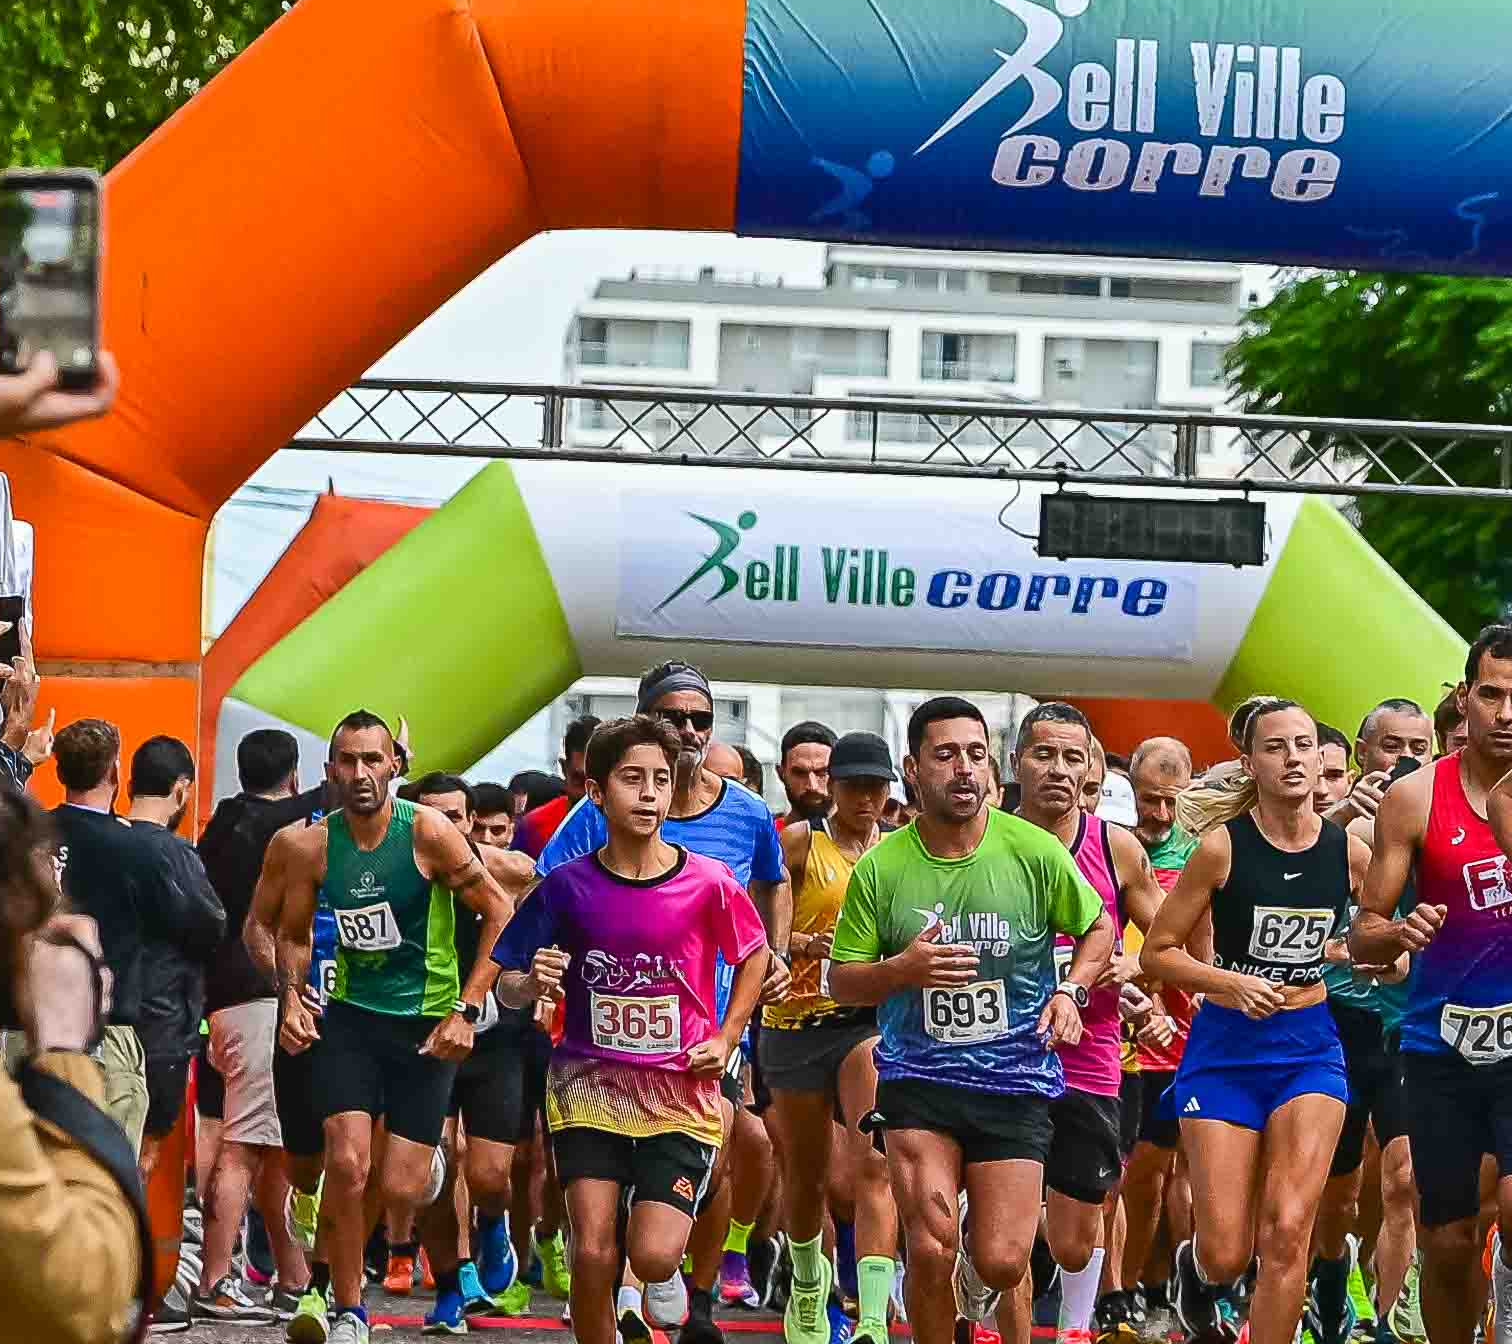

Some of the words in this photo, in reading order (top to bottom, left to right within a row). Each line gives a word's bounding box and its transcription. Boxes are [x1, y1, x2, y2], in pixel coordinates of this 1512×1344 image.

[1191, 41, 1345, 143] Ville
[992, 135, 1341, 201] corre
[822, 545, 915, 607] Ville
[926, 567, 1168, 618] corre
[340, 909, 387, 943] 687
[968, 912, 1010, 941] Ville
[1258, 914, 1328, 950] 625
[596, 1001, 672, 1040] 365
[930, 988, 1000, 1028] 693
